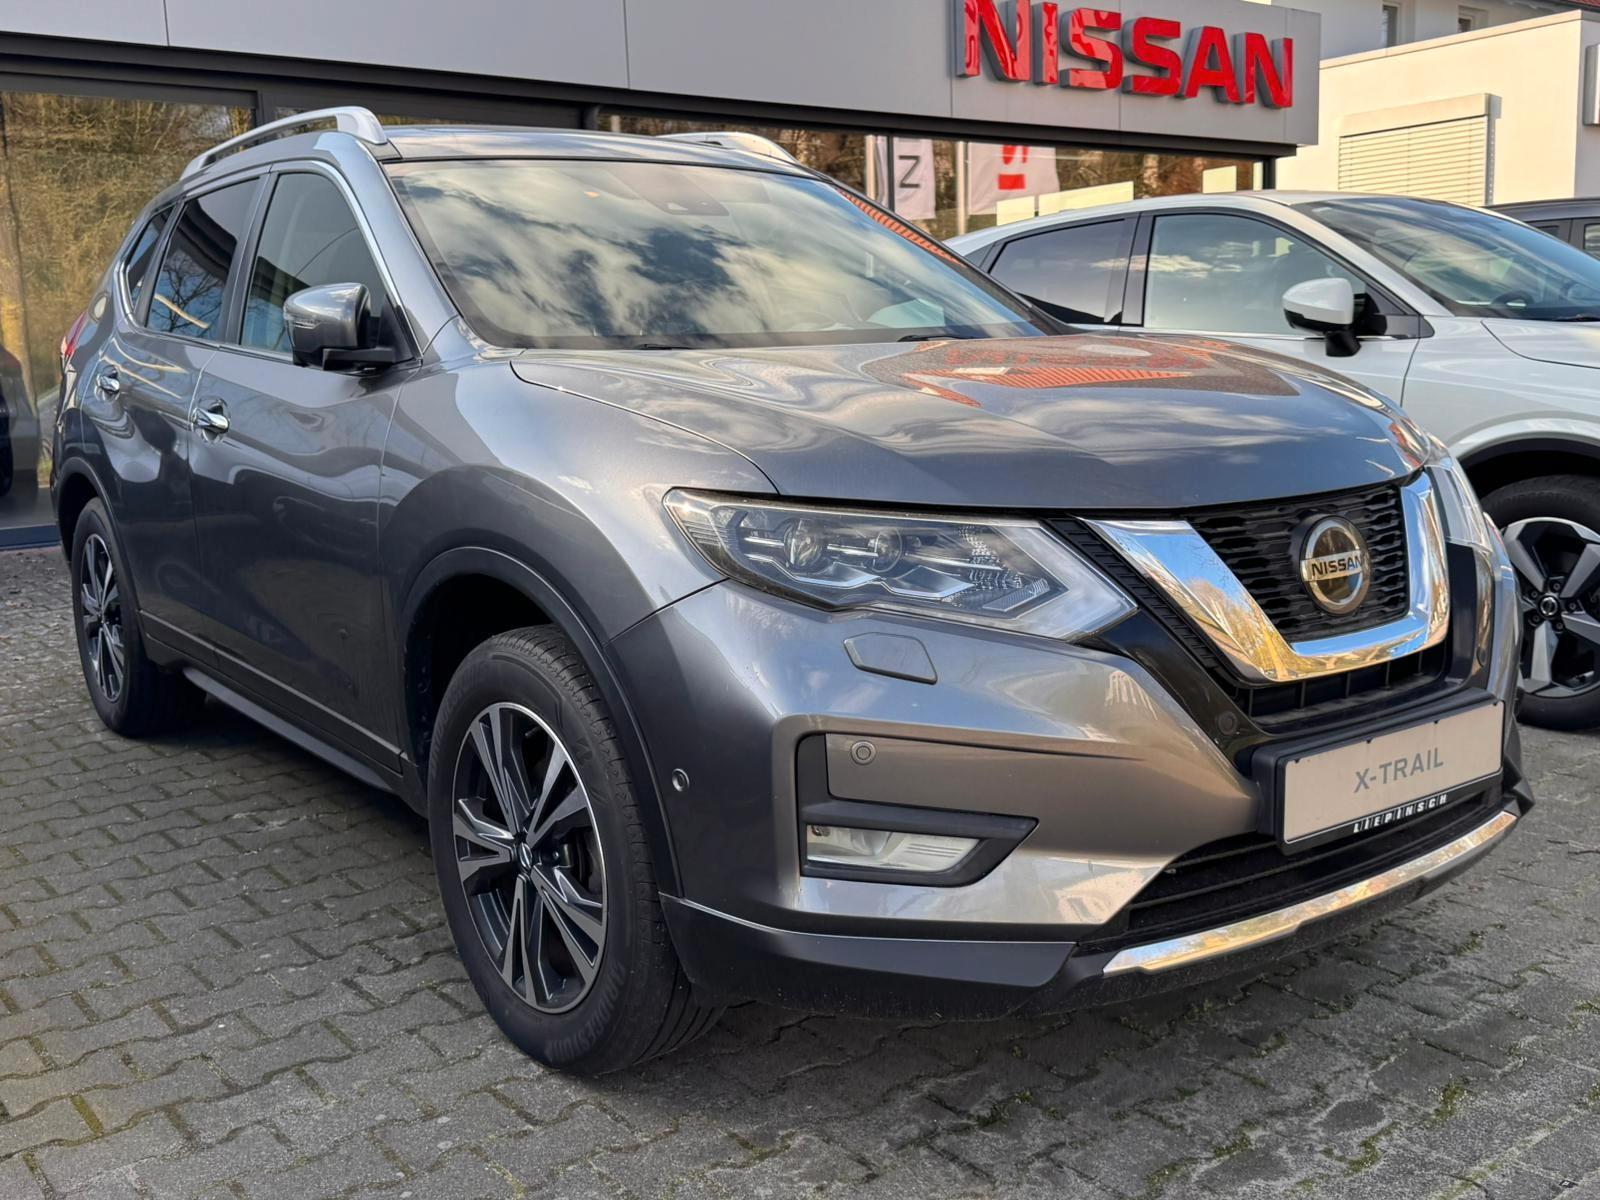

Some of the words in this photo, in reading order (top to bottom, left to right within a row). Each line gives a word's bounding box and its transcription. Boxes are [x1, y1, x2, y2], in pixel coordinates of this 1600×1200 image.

[956, 0, 1293, 108] NISSAN
[1311, 556, 1361, 576] NISSAN
[1354, 747, 1444, 793] X-TRAIL
[1353, 794, 1447, 833] LIEPINSCH
